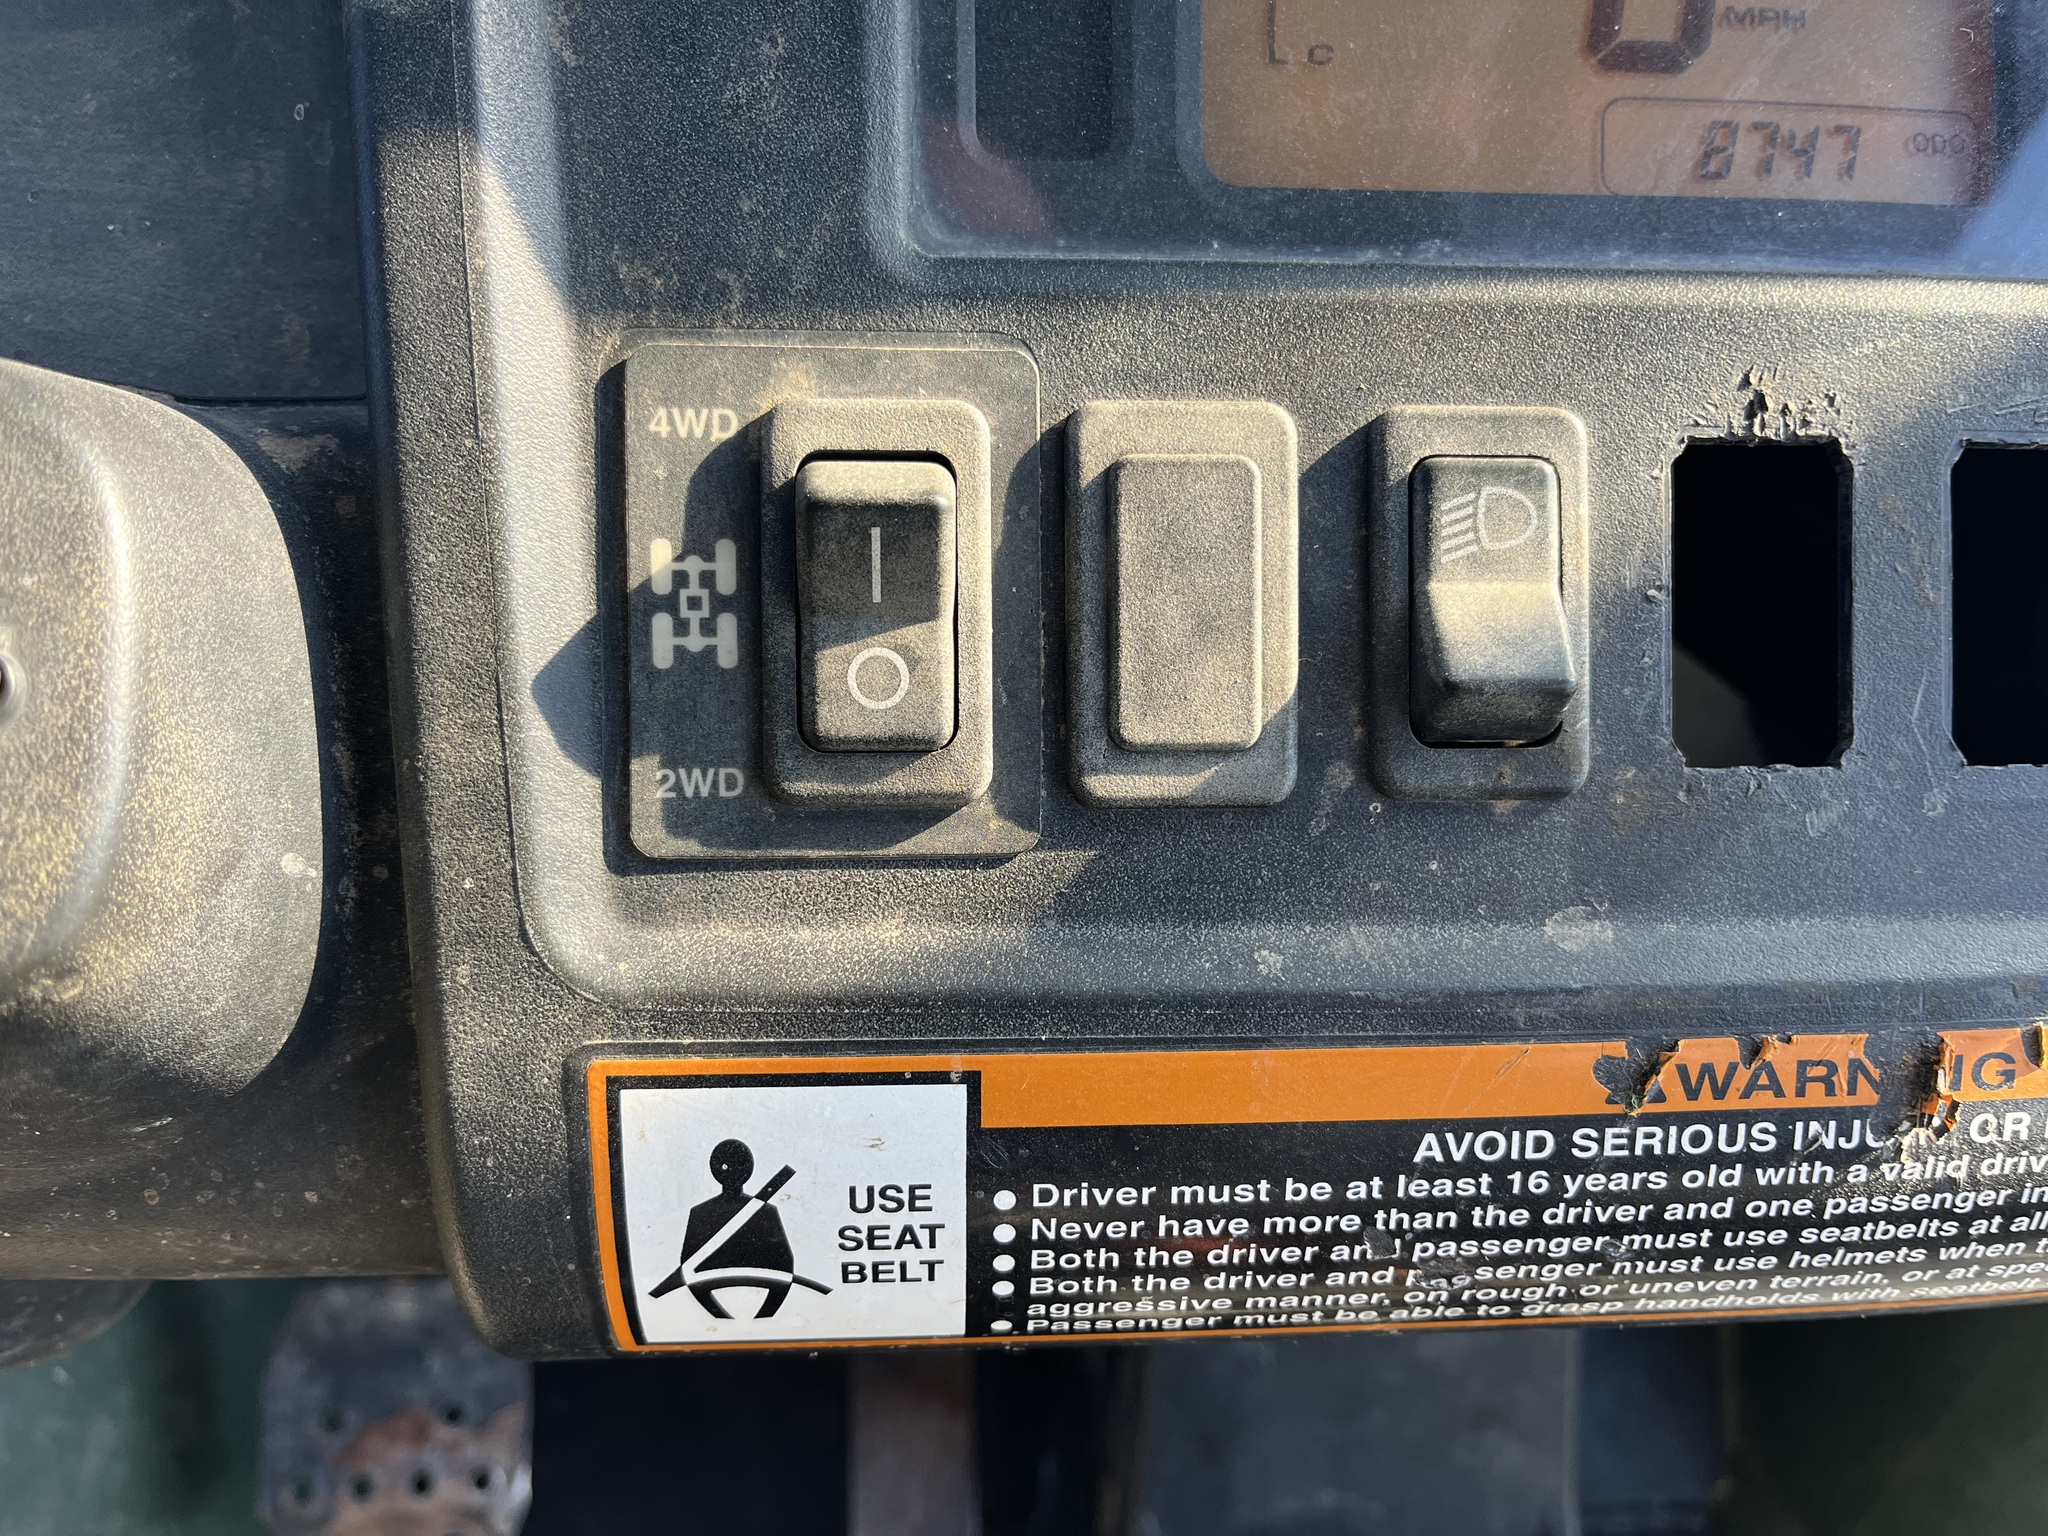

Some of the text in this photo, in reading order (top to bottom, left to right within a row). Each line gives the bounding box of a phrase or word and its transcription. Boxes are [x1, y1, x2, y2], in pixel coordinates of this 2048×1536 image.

[1723, 5, 1806, 29] MPH
[1698, 119, 1861, 181] 8747
[648, 408, 739, 440] 4WD
[655, 767, 745, 800] 2WD
[1413, 1129, 1556, 1163] AVOID
[1571, 1121, 1777, 1159] SERIOUS
[1970, 1111, 2031, 1144] OR
[848, 1183, 933, 1214] USE
[1032, 1182, 1157, 1208] Driver
[1171, 1179, 1270, 1205] must
[1285, 1177, 1333, 1202] be
[1346, 1175, 1384, 1200] at
[1397, 1171, 1493, 1199] least
[1507, 1170, 1550, 1195] 16
[1563, 1167, 1668, 1199] years
[1681, 1163, 1743, 1189] old
[1755, 1158, 1834, 1187] with
[1847, 1163, 1868, 1184] a
[1879, 1152, 1970, 1182] valid
[1031, 1182, 2048, 1241] Never have more than the driver and one passenger in
[837, 1223, 946, 1252] SEAT
[1030, 1246, 1120, 1270] Both
[1133, 1246, 1194, 1269] the
[1206, 1241, 1320, 1268] driver
[1411, 1234, 1611, 1263] passenger
[1620, 1227, 1714, 1251] must
[1723, 1228, 1789, 1248] use
[1798, 1217, 1961, 1245] seatbelts
[1967, 1214, 2004, 1236] at
[2008, 1210, 2048, 1233] all
[841, 1260, 946, 1284] BELT
[1027, 1295, 1232, 1318] aggressive
[1245, 1291, 1391, 1310] manner,
[1403, 1289, 1449, 1305] on
[1461, 1282, 1568, 1304] rough
[1579, 1282, 1619, 1298] or
[1628, 1277, 1759, 1296] uneven
[1901, 1269, 1941, 1283] or
[1945, 1264, 1981, 1281] at
[1029, 1274, 1118, 1296] Both
[1131, 1273, 1191, 1294] the
[1203, 1270, 1316, 1292] driver
[1325, 1266, 1396, 1287] and
[1611, 1255, 1705, 1278] must
[1713, 1255, 1780, 1273] use
[1788, 1246, 1929, 1270] helmets
[1938, 1241, 2028, 1262] when
[1026, 1314, 1223, 1334] Passenger
[1233, 1309, 1325, 1327] must
[1334, 1308, 1380, 1323] be
[1389, 1304, 1466, 1321] able
[1475, 1303, 1512, 1317] to
[1521, 1300, 1624, 1317] grasp
[1634, 1291, 1822, 1313] handholds
[1831, 1287, 1900, 1301] with
